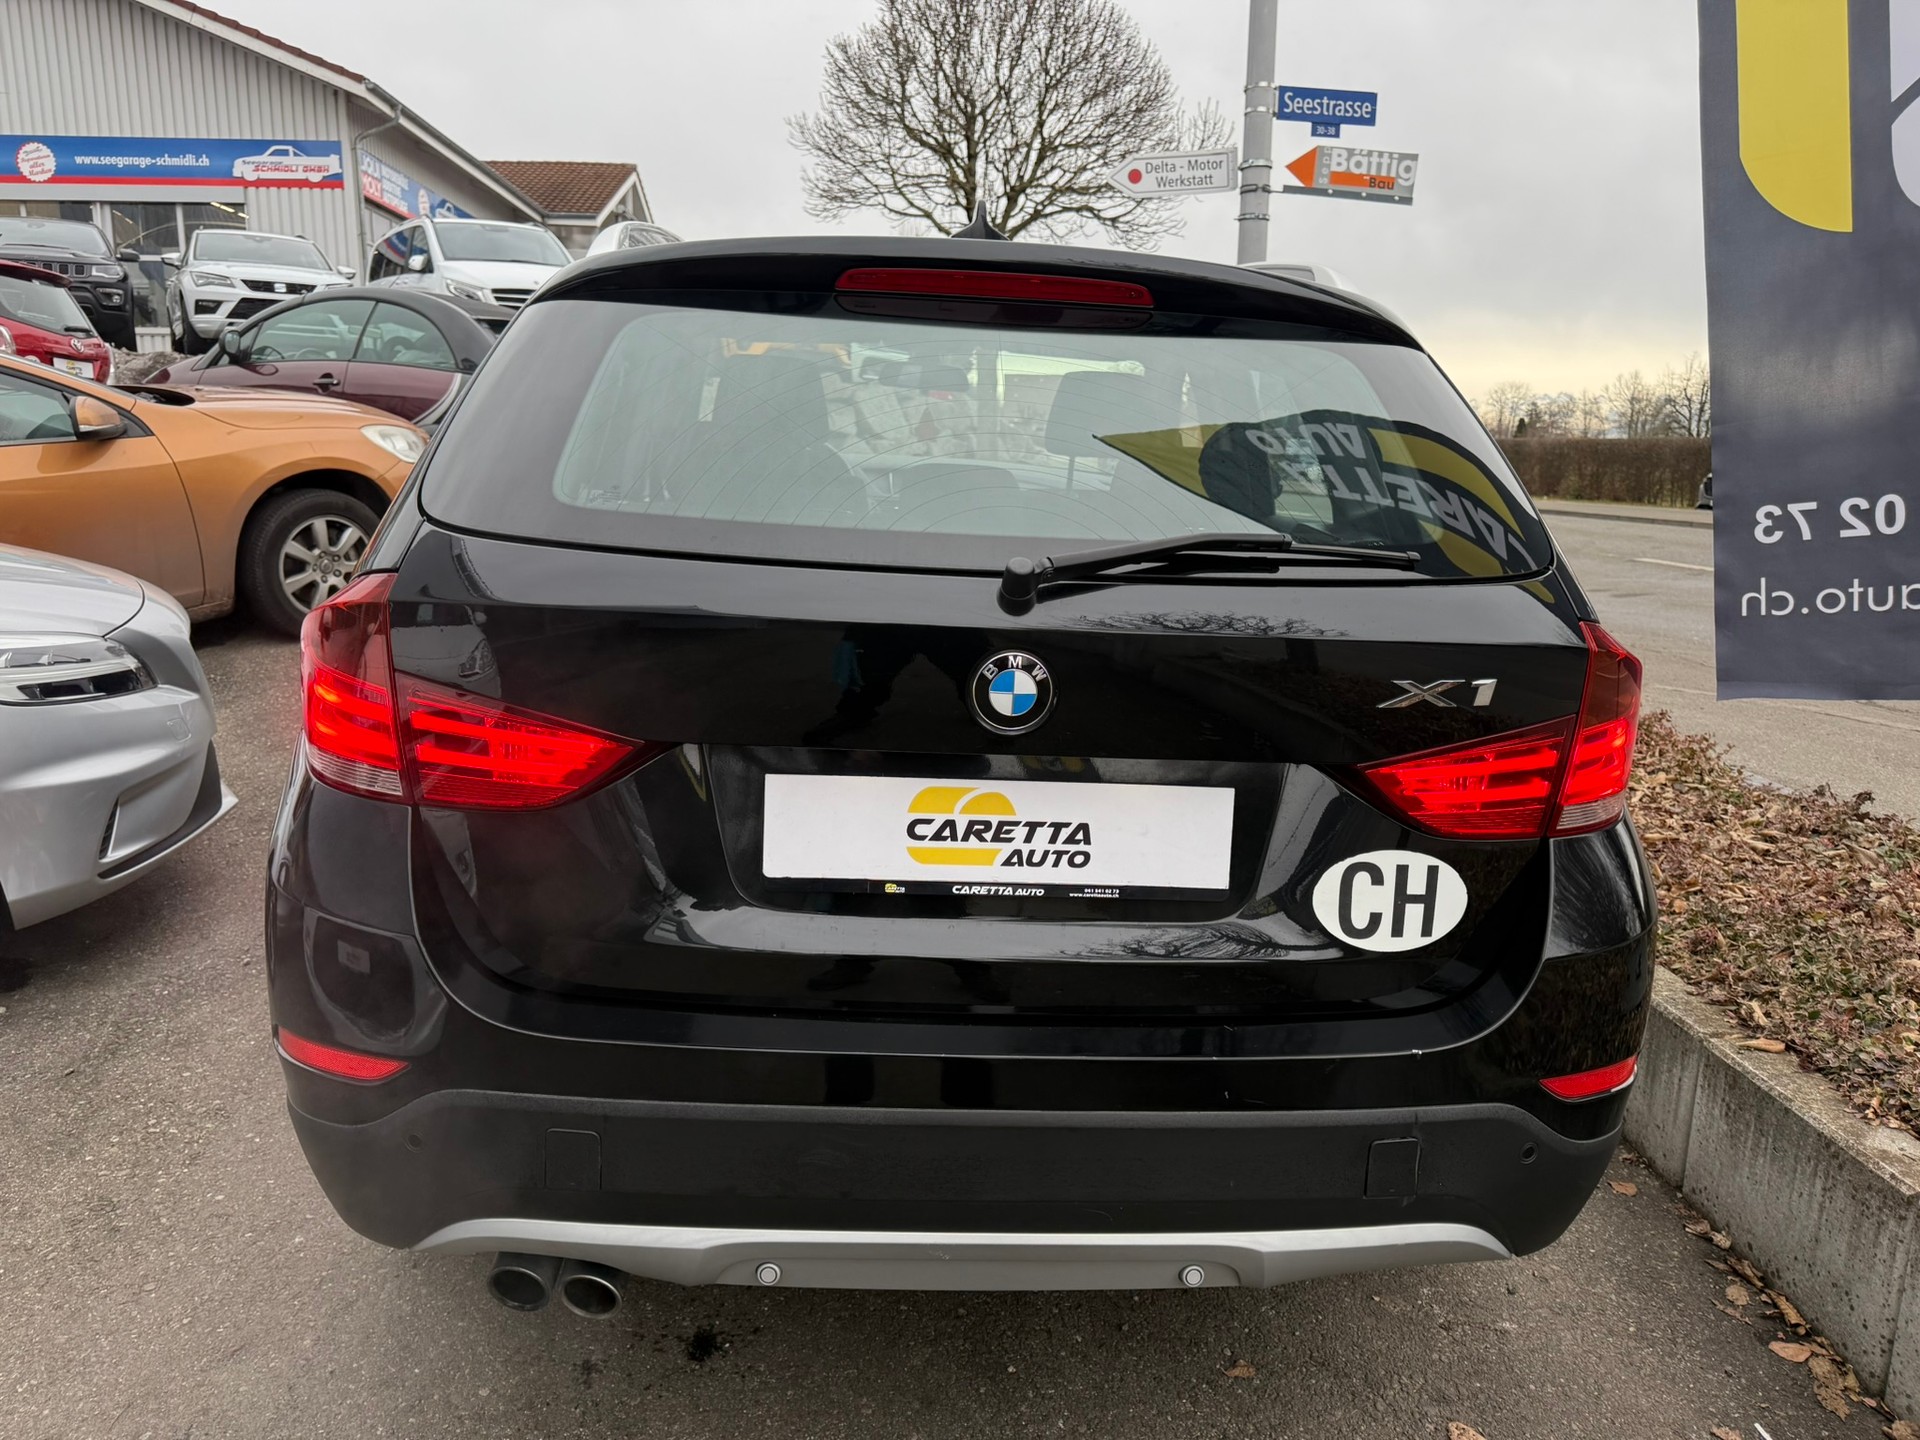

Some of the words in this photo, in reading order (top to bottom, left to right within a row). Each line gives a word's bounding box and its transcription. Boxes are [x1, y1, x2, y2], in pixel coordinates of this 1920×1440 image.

[1283, 91, 1372, 118] Seestrasse
[1316, 126, 1336, 136] 30-38
[74, 153, 210, 168] www.seegarage-schmidli.ch
[1145, 161, 1176, 174] Delta
[1187, 159, 1224, 172] Motor
[1330, 148, 1418, 187] Bättig
[1156, 174, 1214, 188] Werkstatt
[1369, 178, 1395, 190] Bau
[982, 656, 1047, 682] BMW
[1376, 679, 1498, 708] X1
[906, 818, 1091, 846] CARETTA
[1000, 848, 1091, 869] AUTO
[952, 885, 1014, 896] CARETTA
[1014, 887, 1045, 897] AUTO
[1338, 861, 1440, 940] CH
